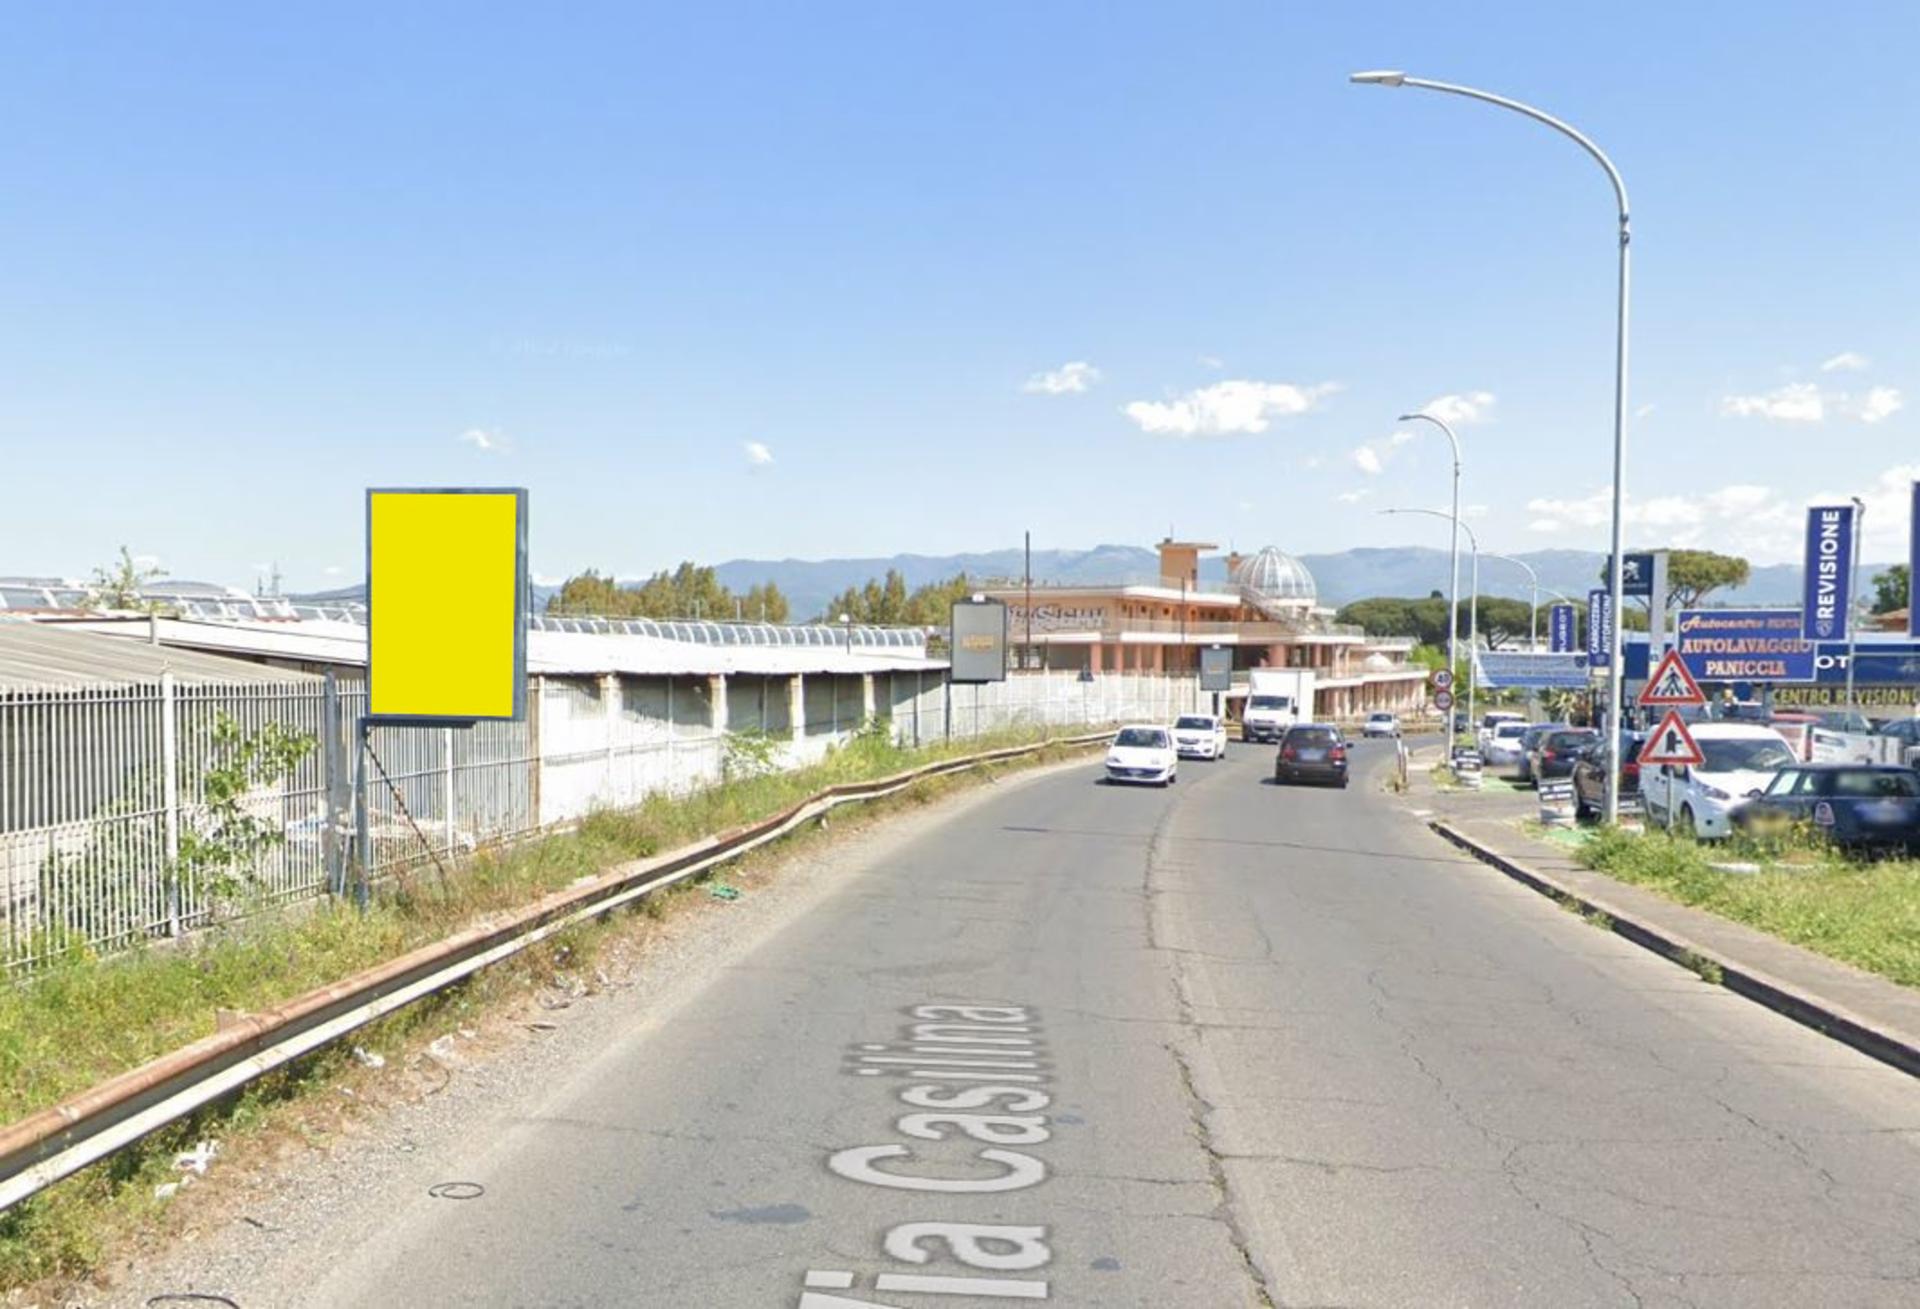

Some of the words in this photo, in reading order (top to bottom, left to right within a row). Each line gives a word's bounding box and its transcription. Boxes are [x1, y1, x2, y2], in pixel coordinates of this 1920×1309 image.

[1817, 509, 1840, 620] REVISIONE
[1681, 637, 1813, 654] AUTOLAVAGGIO
[1705, 660, 1787, 676] PANICCIA
[1772, 688, 1830, 704] CENTRO
